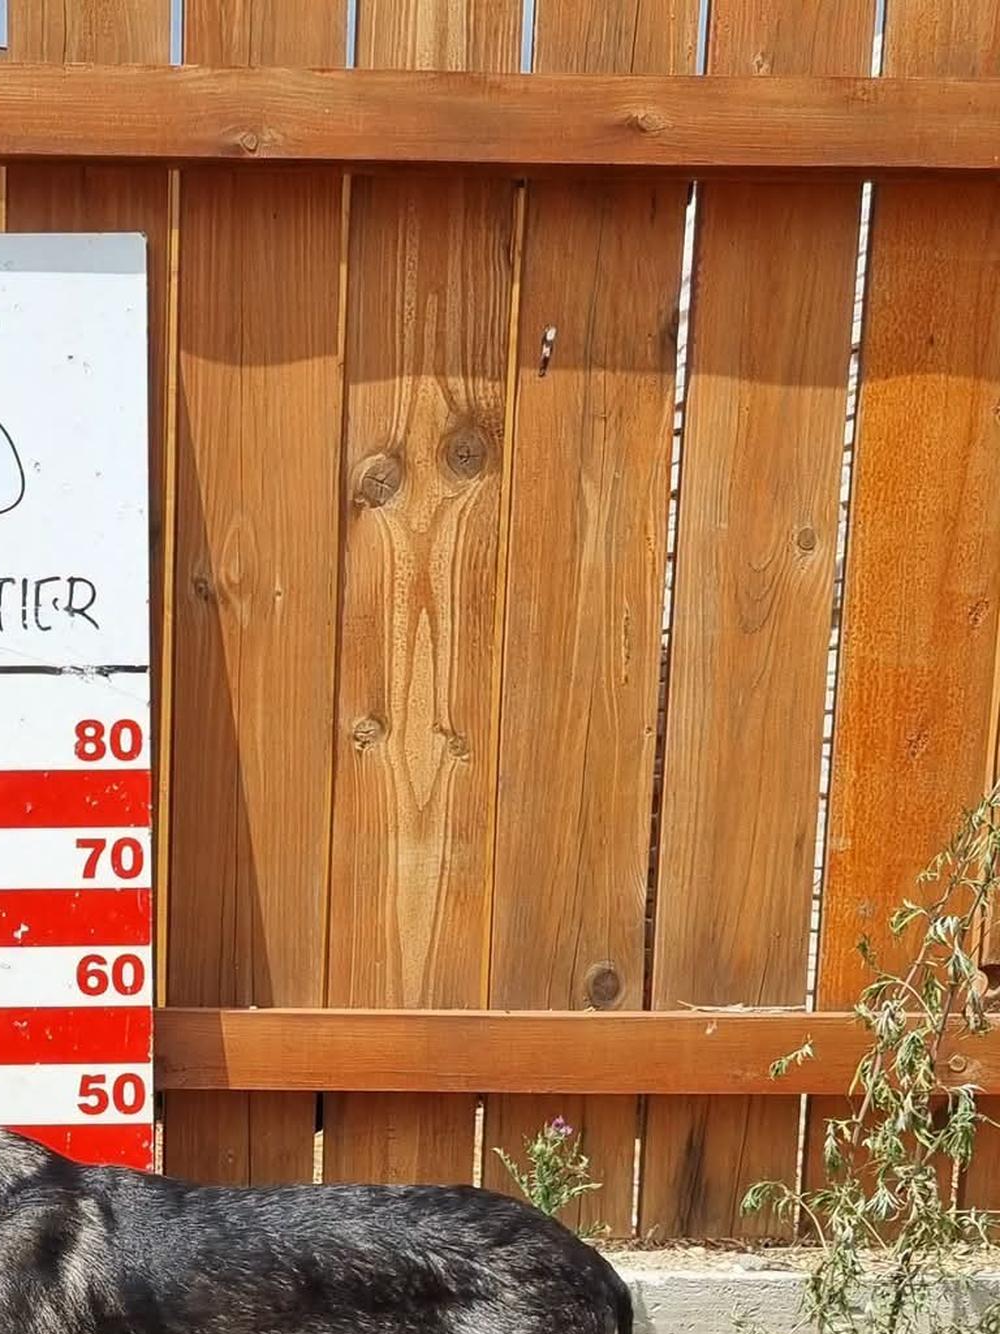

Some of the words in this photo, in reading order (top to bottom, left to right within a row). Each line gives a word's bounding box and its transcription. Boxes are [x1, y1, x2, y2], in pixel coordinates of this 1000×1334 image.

[73, 718, 144, 762] 80
[74, 837, 145, 880] 70
[75, 953, 146, 996] 60
[77, 1073, 147, 1115] 50
